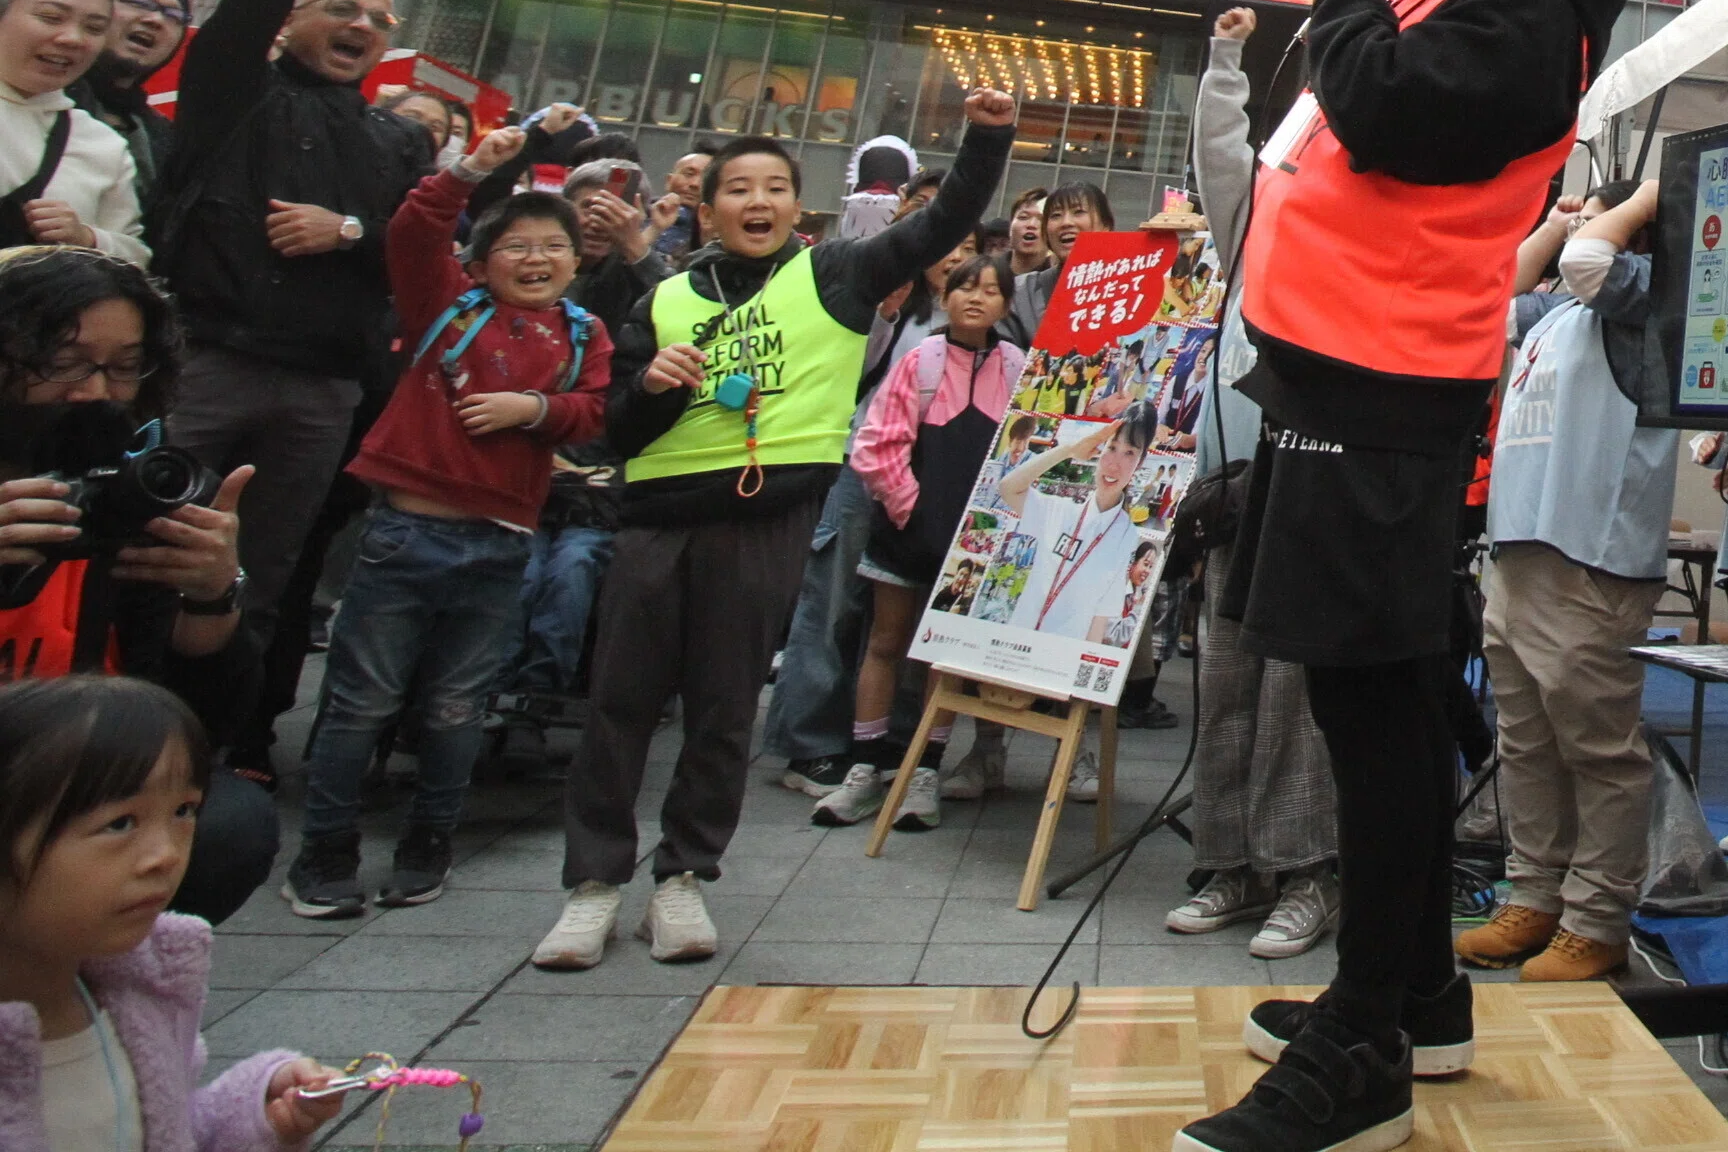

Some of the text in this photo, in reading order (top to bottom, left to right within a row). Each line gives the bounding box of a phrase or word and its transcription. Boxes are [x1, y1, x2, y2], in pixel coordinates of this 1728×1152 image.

[1066, 248, 1164, 289] 情熱があれば
[1073, 274, 1146, 306] なんだって
